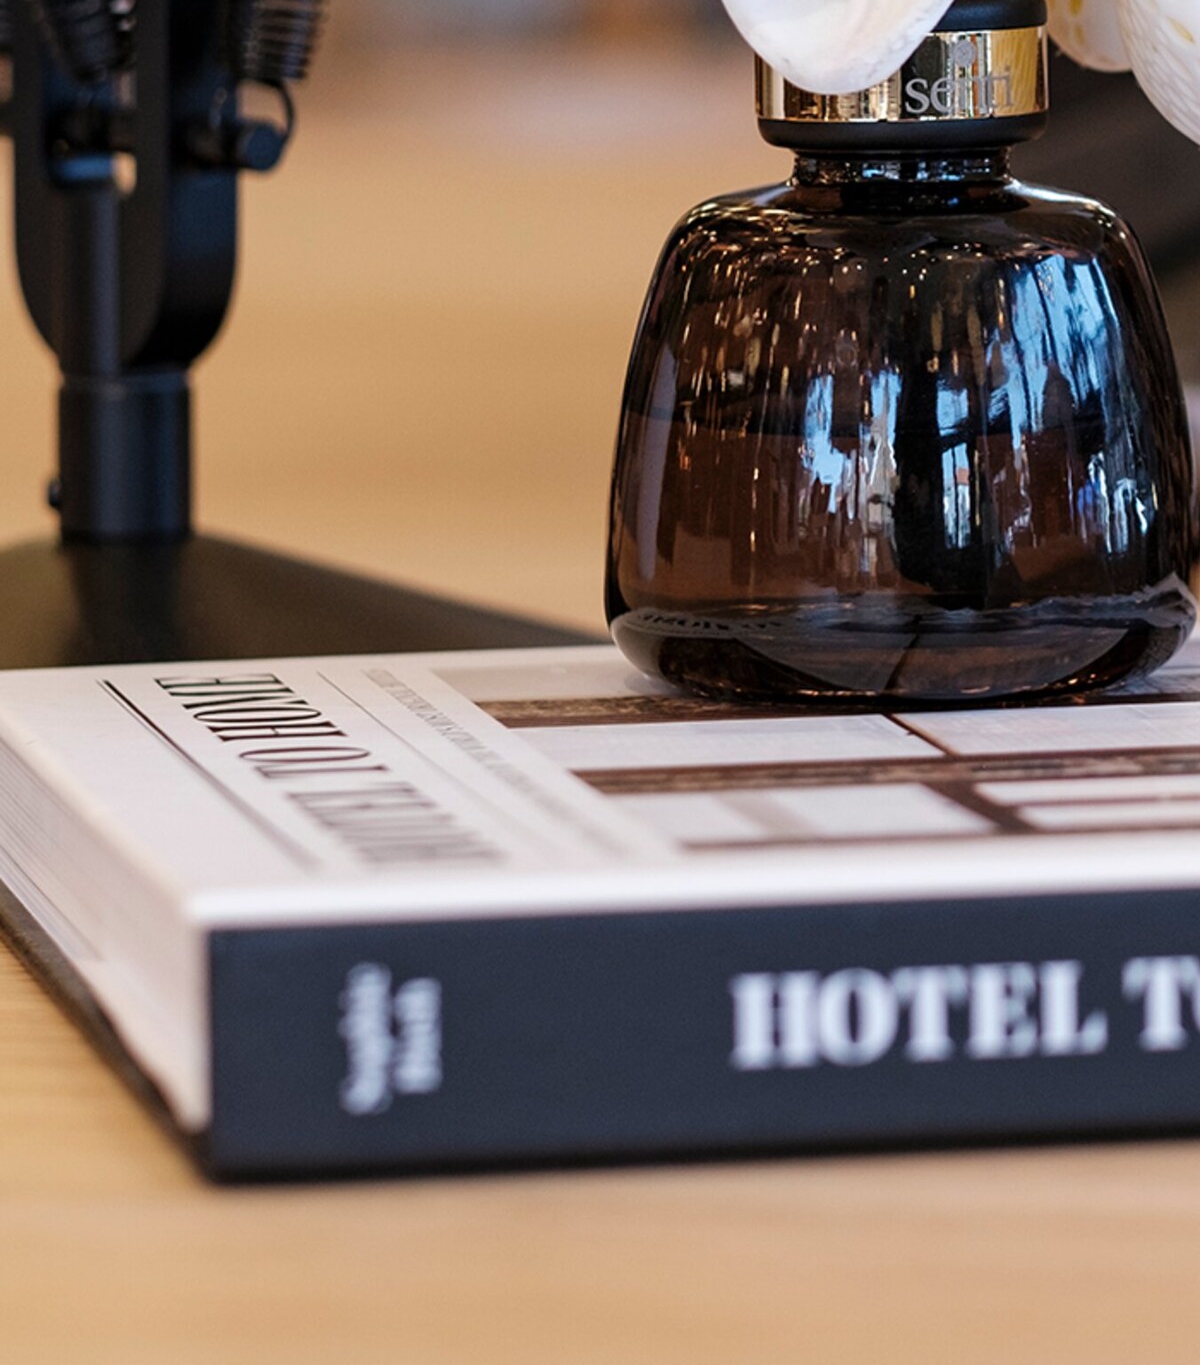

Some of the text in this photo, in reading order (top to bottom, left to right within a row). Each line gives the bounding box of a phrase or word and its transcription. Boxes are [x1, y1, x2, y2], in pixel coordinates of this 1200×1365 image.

[154, 673, 348, 742] HOME
[239, 746, 388, 779] TO
[731, 962, 1108, 1069] HOTEL
